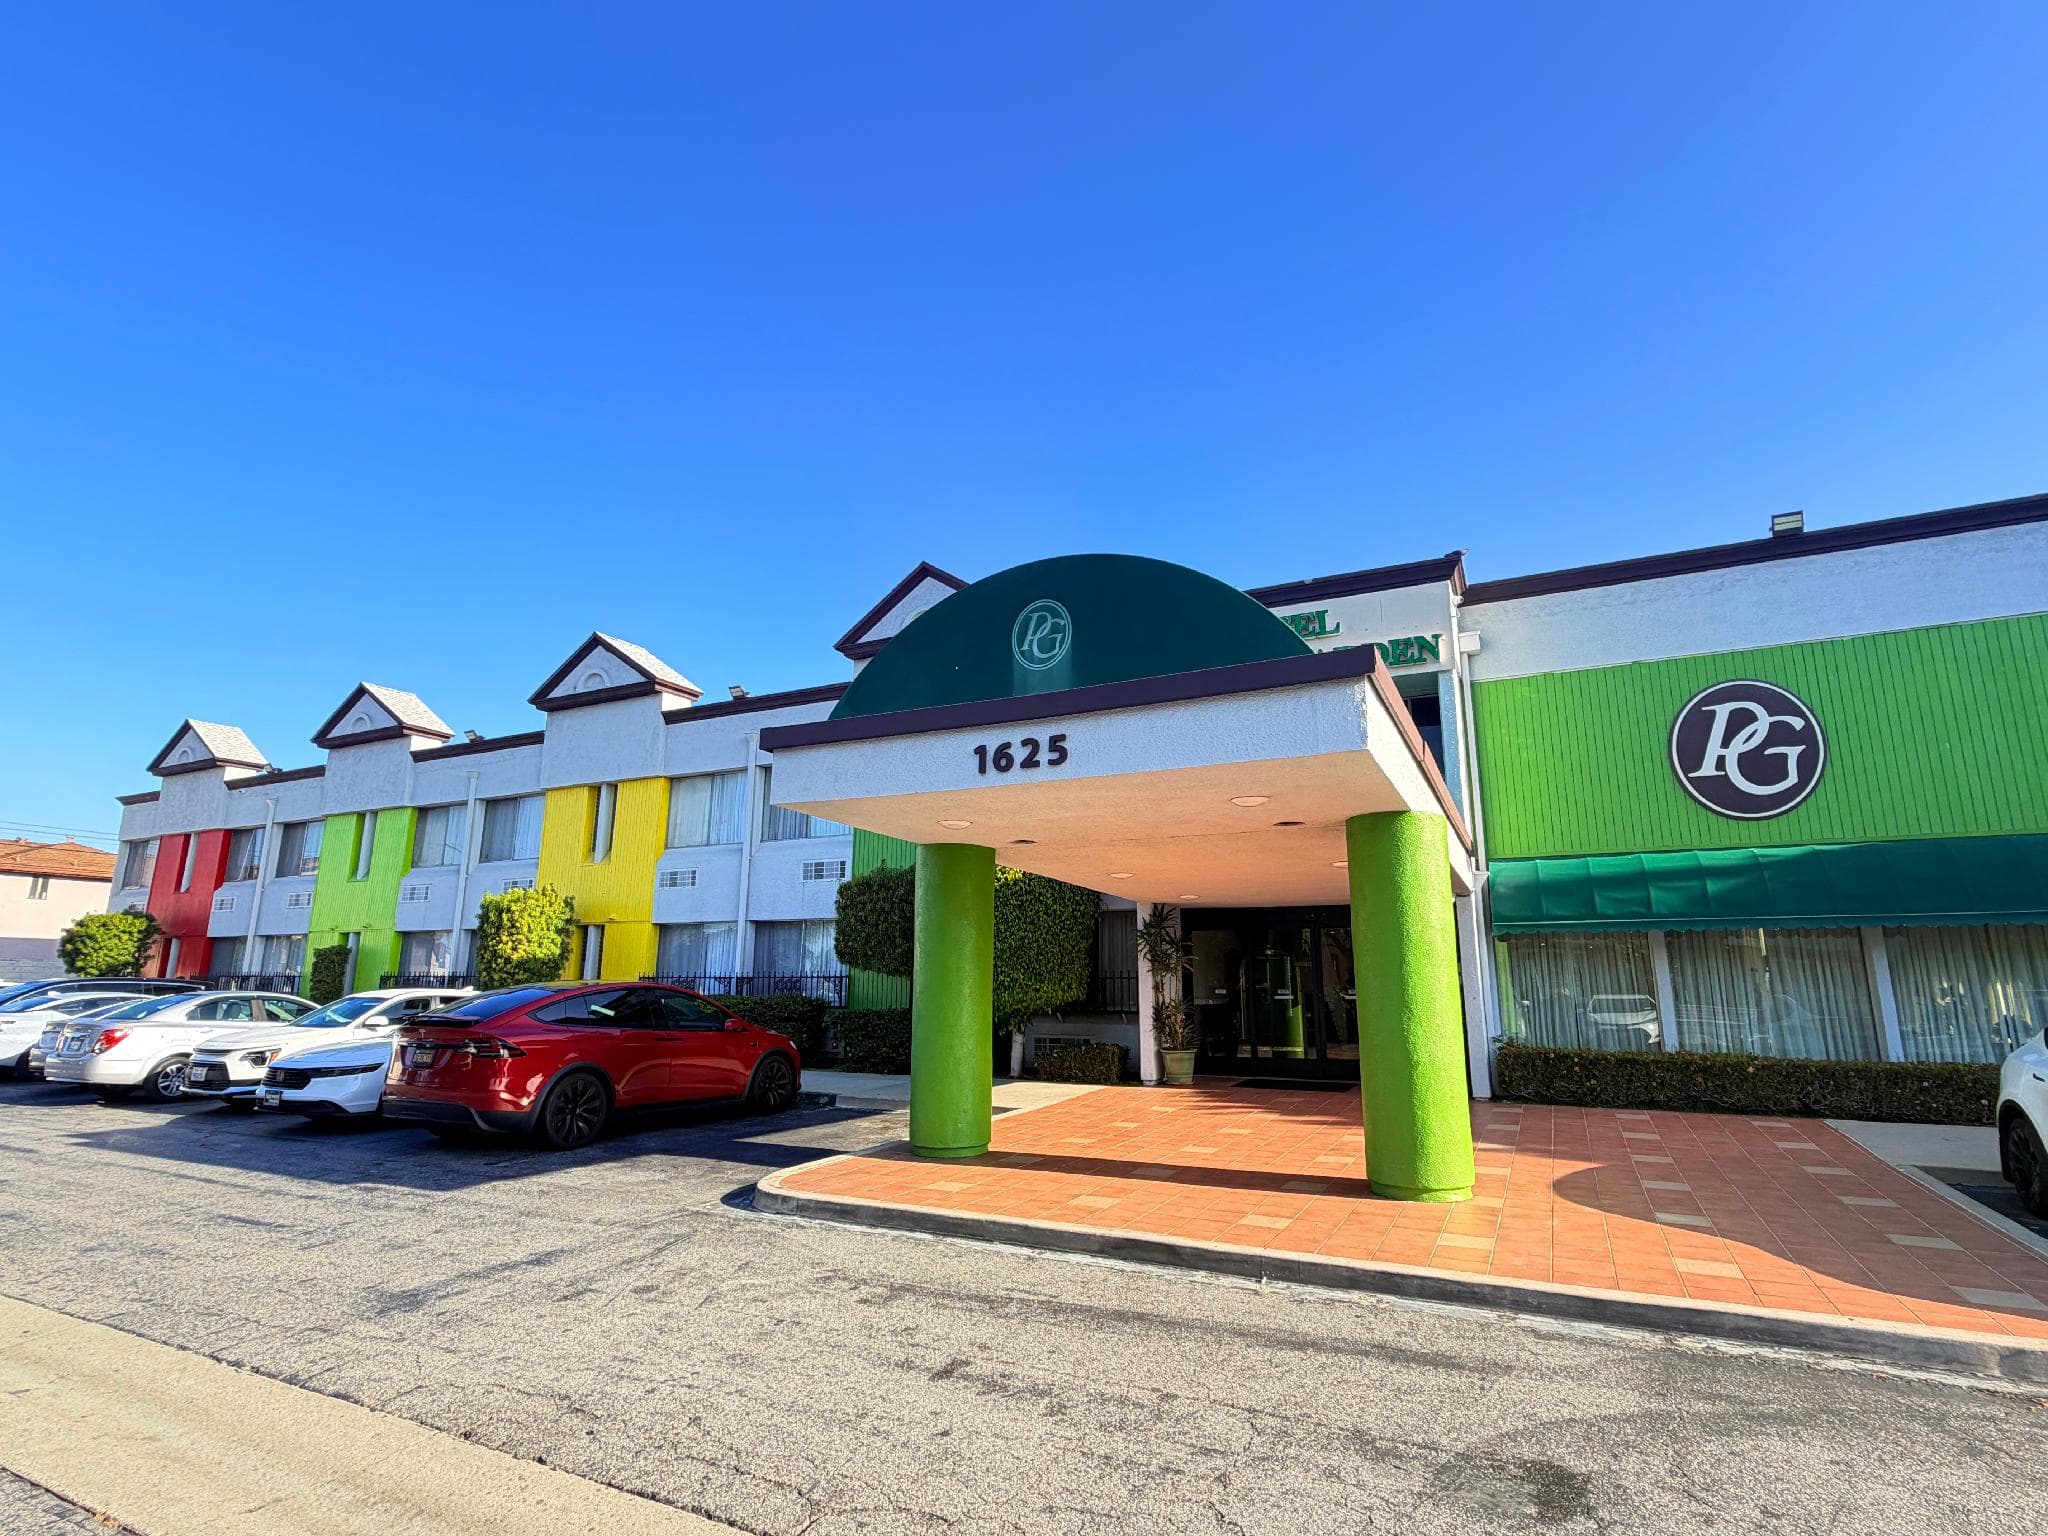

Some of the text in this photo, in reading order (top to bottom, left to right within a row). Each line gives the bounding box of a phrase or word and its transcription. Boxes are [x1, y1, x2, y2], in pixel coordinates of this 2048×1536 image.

[1280, 610, 1341, 639] EL
[1333, 634, 1443, 667] DEN
[973, 734, 1068, 774] 1625
[1687, 701, 1807, 795] PG
